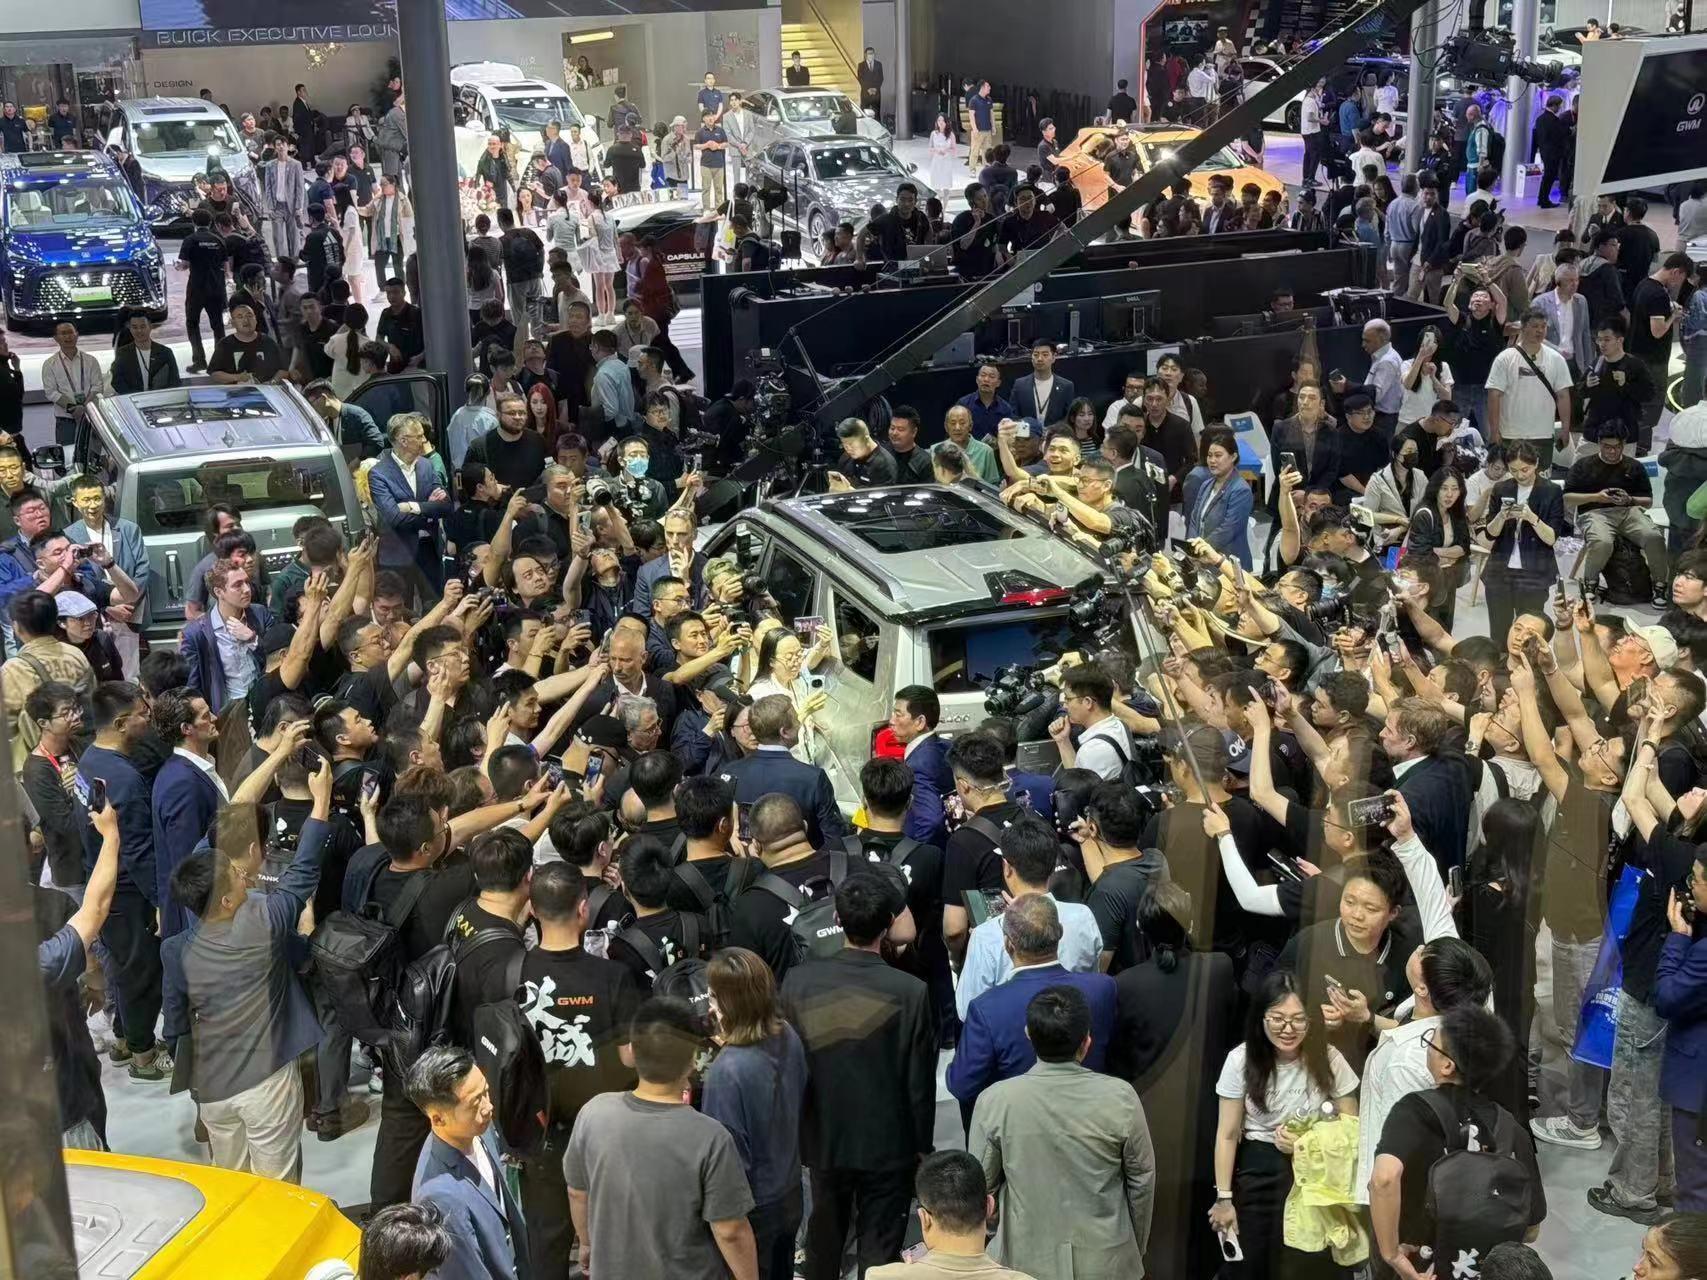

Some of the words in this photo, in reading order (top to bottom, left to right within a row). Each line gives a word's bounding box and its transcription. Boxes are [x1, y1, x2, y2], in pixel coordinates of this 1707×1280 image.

[156, 28, 221, 45] BUICK
[228, 25, 343, 42] EXECUTIVE
[153, 80, 193, 88] DESIGN
[1676, 119, 1702, 132] GWM
[667, 252, 705, 261] CAPSULE
[257, 873, 280, 883] TANK
[557, 995, 594, 1006] GWM
[481, 1035, 498, 1056] GWM
